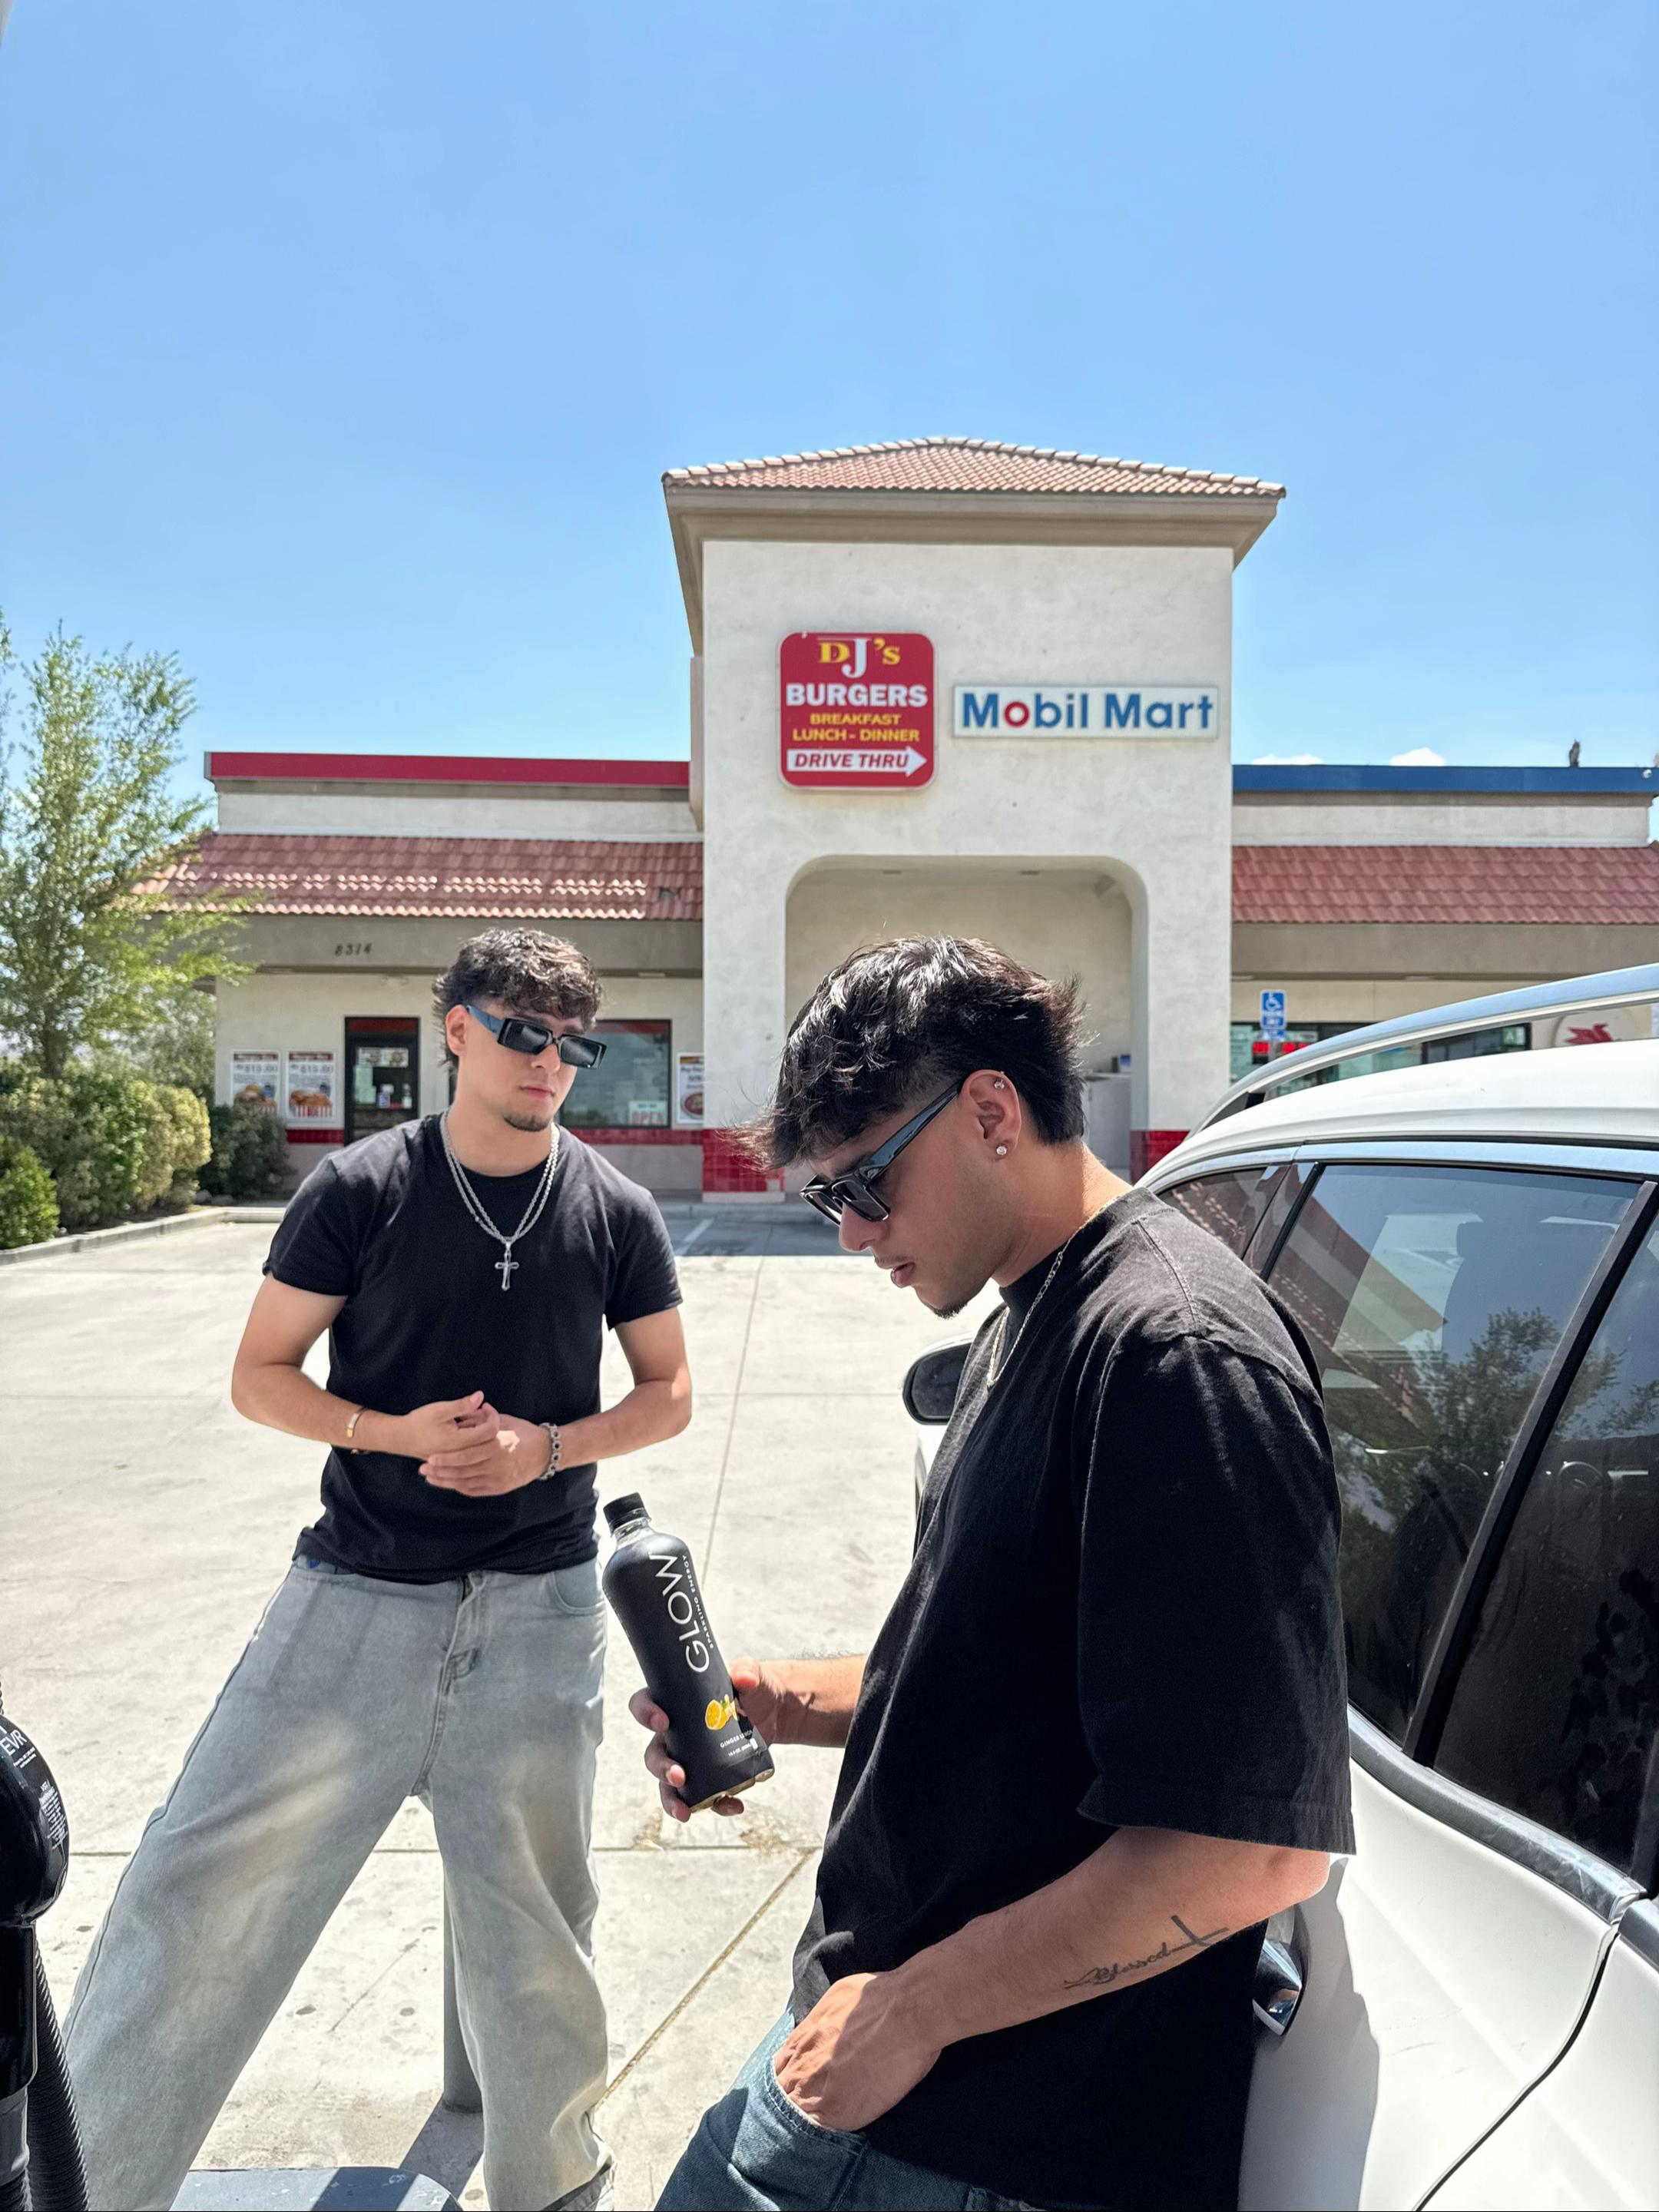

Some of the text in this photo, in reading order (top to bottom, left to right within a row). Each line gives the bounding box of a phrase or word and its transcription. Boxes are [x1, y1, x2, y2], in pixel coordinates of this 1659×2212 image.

[817, 637, 902, 678] DJ's
[786, 683, 929, 707] BURGERS
[810, 713, 902, 726] BREAKFAST
[962, 692, 1214, 729] Mobil Mart
[793, 728, 846, 741] LUNCH
[859, 729, 920, 742] DINNER
[794, 753, 909, 767] DRIVE THRU
[335, 942, 373, 957] 8314
[649, 1554, 710, 1673] GLOW
[682, 1555, 714, 1649] SPARKLING ENERGY
[0, 1729, 28, 1756] EVR
[720, 1734, 740, 1748] GINGER
